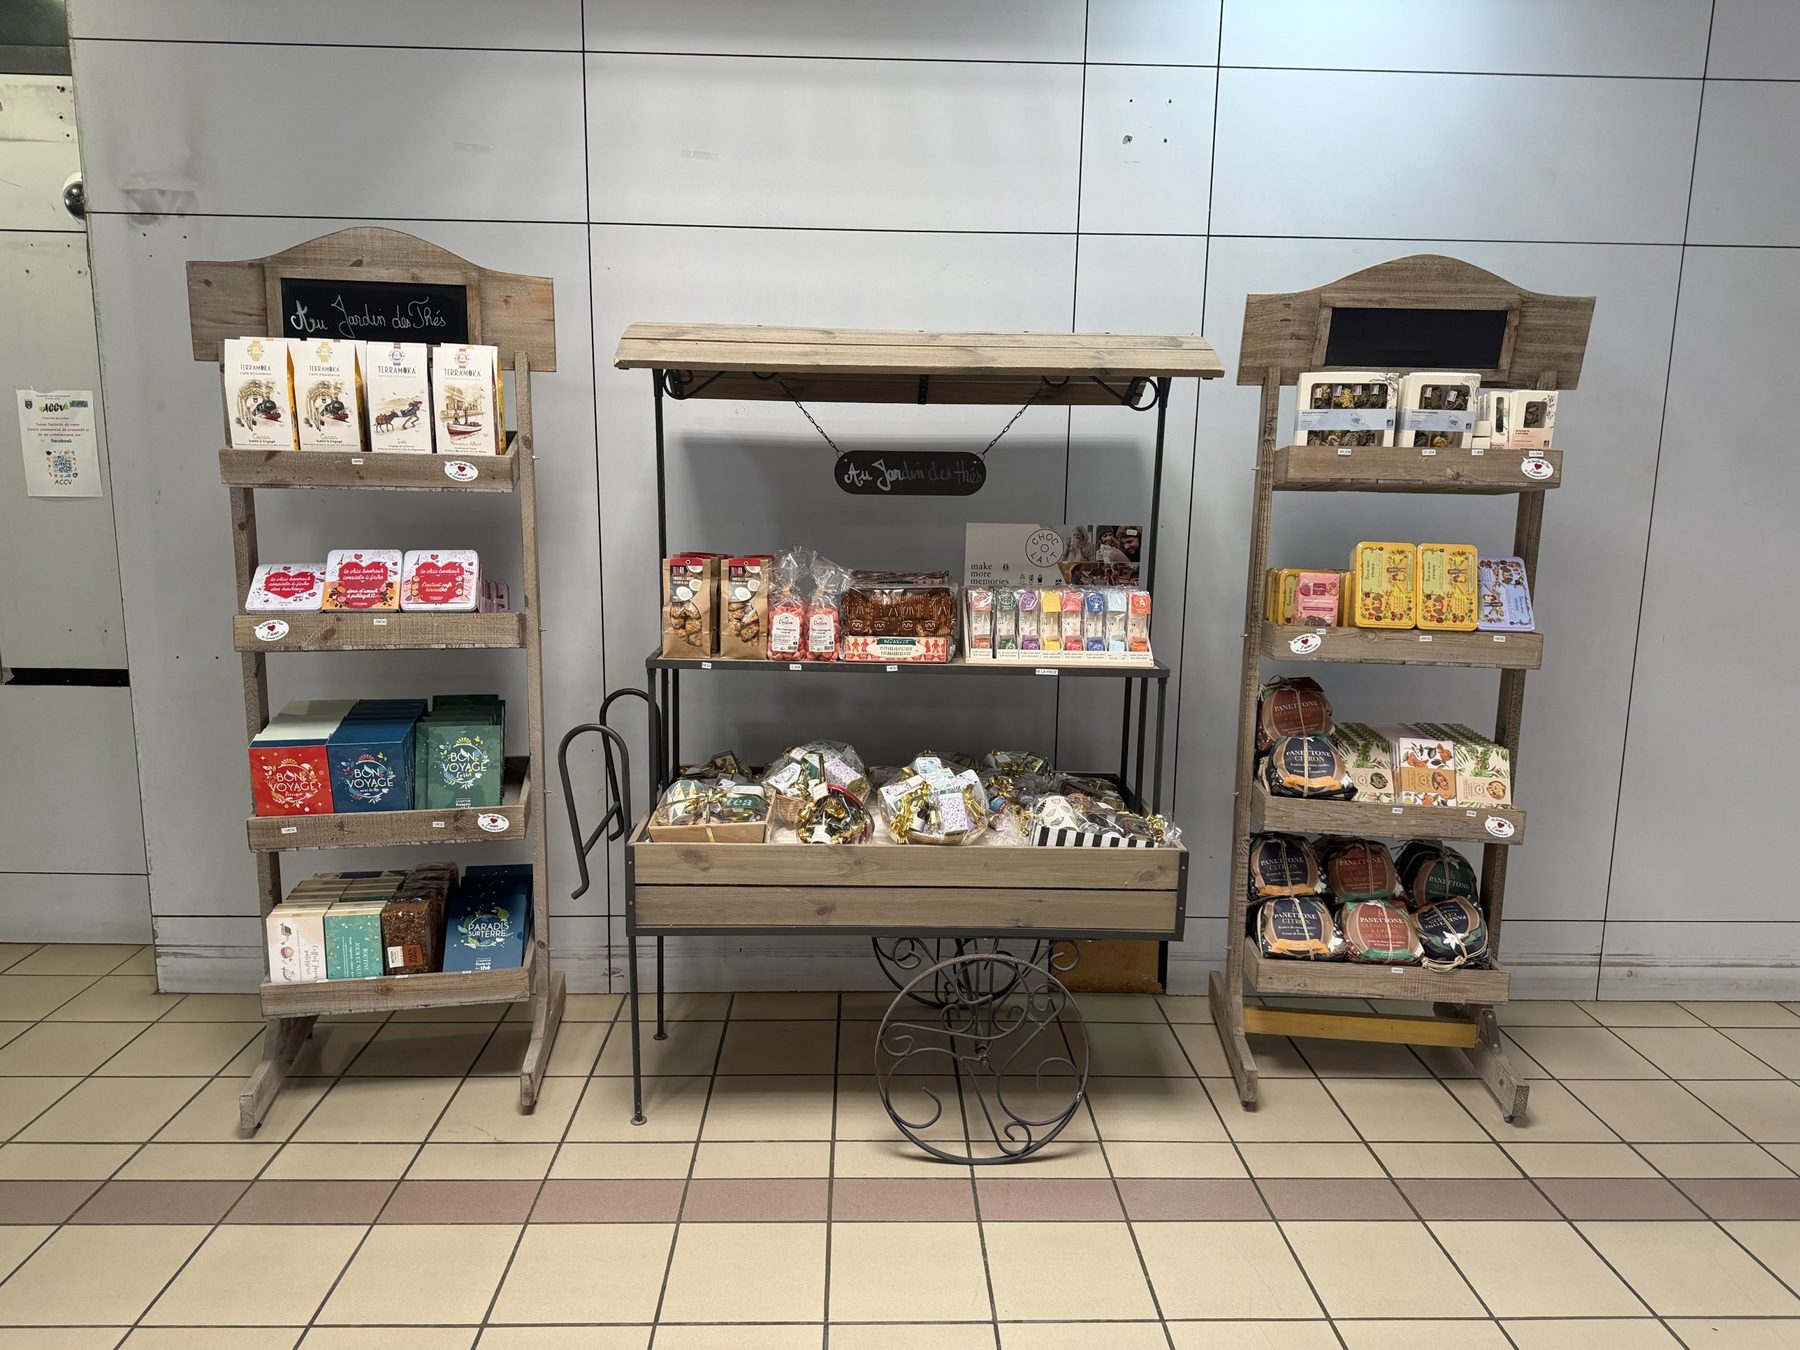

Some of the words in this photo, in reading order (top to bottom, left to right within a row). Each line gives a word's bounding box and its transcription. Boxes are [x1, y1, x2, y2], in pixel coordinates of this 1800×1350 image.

[290, 299, 328, 333] Au
[331, 294, 386, 338] Jardin
[392, 305, 411, 329] des
[408, 296, 447, 329] Thés
[378, 365, 416, 374] TERRAMOKA
[444, 368, 481, 377] TERRAMOKA
[43, 402, 66, 413] ACCV
[844, 462, 873, 487] Au
[872, 458, 925, 491] Jardin
[928, 460, 951, 481] des
[970, 562, 992, 570] make
[450, 752, 475, 762] BON
[442, 762, 487, 772] VOYAGE
[277, 772, 303, 782] BON
[354, 768, 380, 778] BON
[269, 782, 315, 792] VOYAGE
[346, 778, 394, 788] VOYAGE
[726, 798, 752, 806] tea
[468, 922, 509, 931] PARADIS
